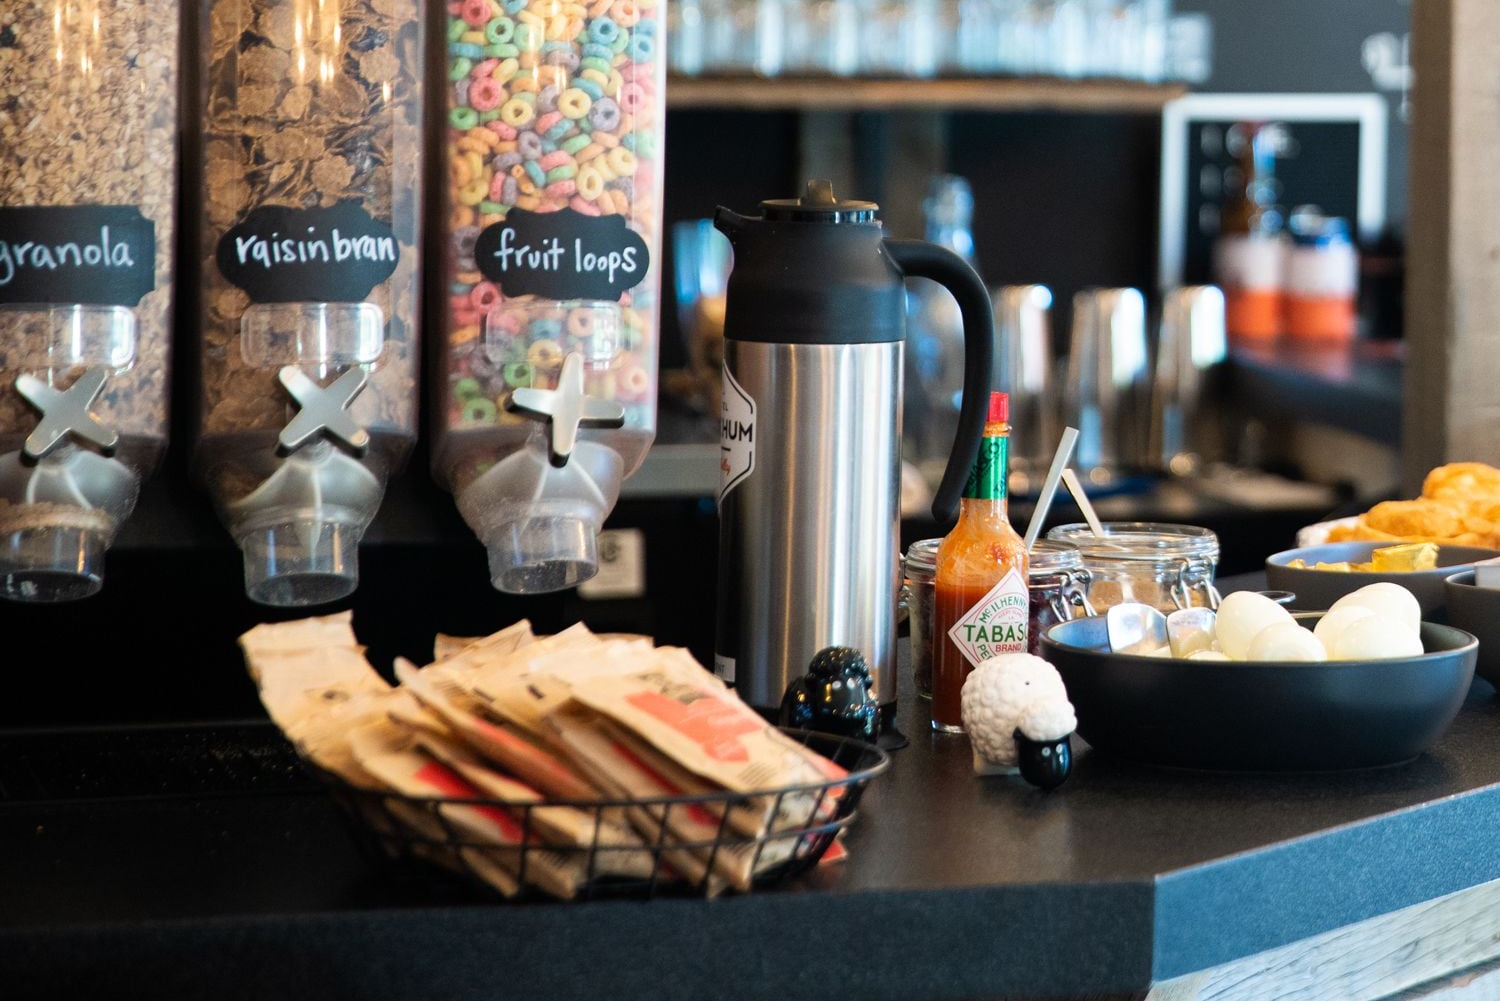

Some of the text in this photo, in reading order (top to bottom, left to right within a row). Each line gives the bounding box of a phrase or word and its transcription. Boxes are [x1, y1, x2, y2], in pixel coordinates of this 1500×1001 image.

[494, 228, 637, 283] fruit loops
[721, 419, 753, 443] HUM
